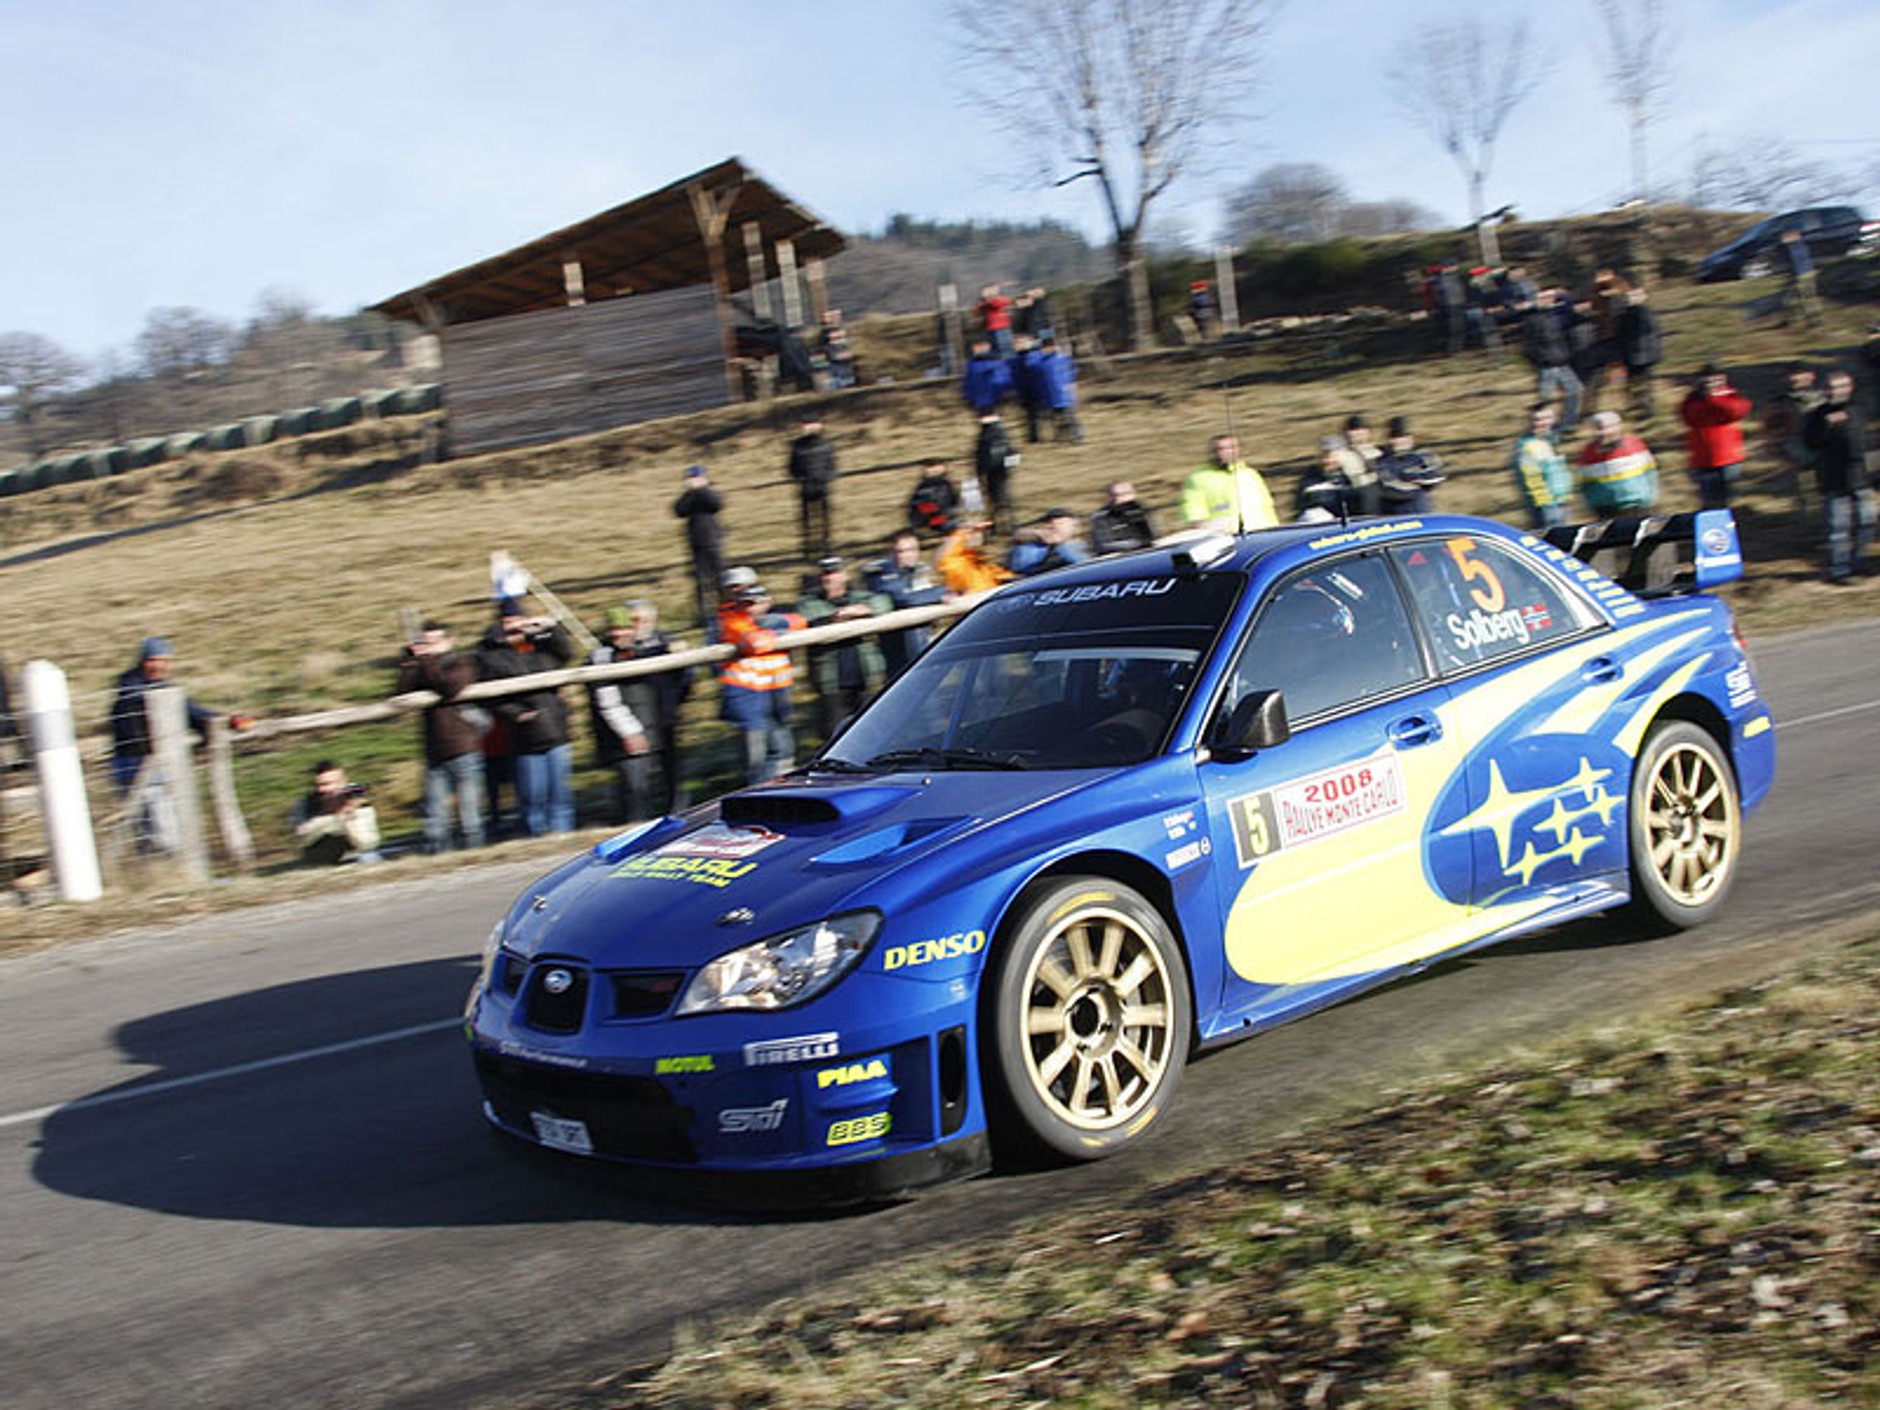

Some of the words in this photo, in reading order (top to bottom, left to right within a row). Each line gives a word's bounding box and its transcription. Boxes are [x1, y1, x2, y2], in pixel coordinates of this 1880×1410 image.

[1033, 578, 1178, 606] SUBARU
[1447, 536, 1506, 613] 5
[1446, 608, 1532, 650] Solberg
[1282, 800, 1325, 839] RALLYE
[1325, 796, 1363, 826] MONTE
[1363, 768, 1399, 814] CARLO
[1304, 768, 1373, 803] 2008
[1242, 796, 1271, 856] 5
[884, 930, 986, 971] DENSO
[743, 1031, 840, 1066] PIRELLI
[818, 1060, 888, 1089] PIAA
